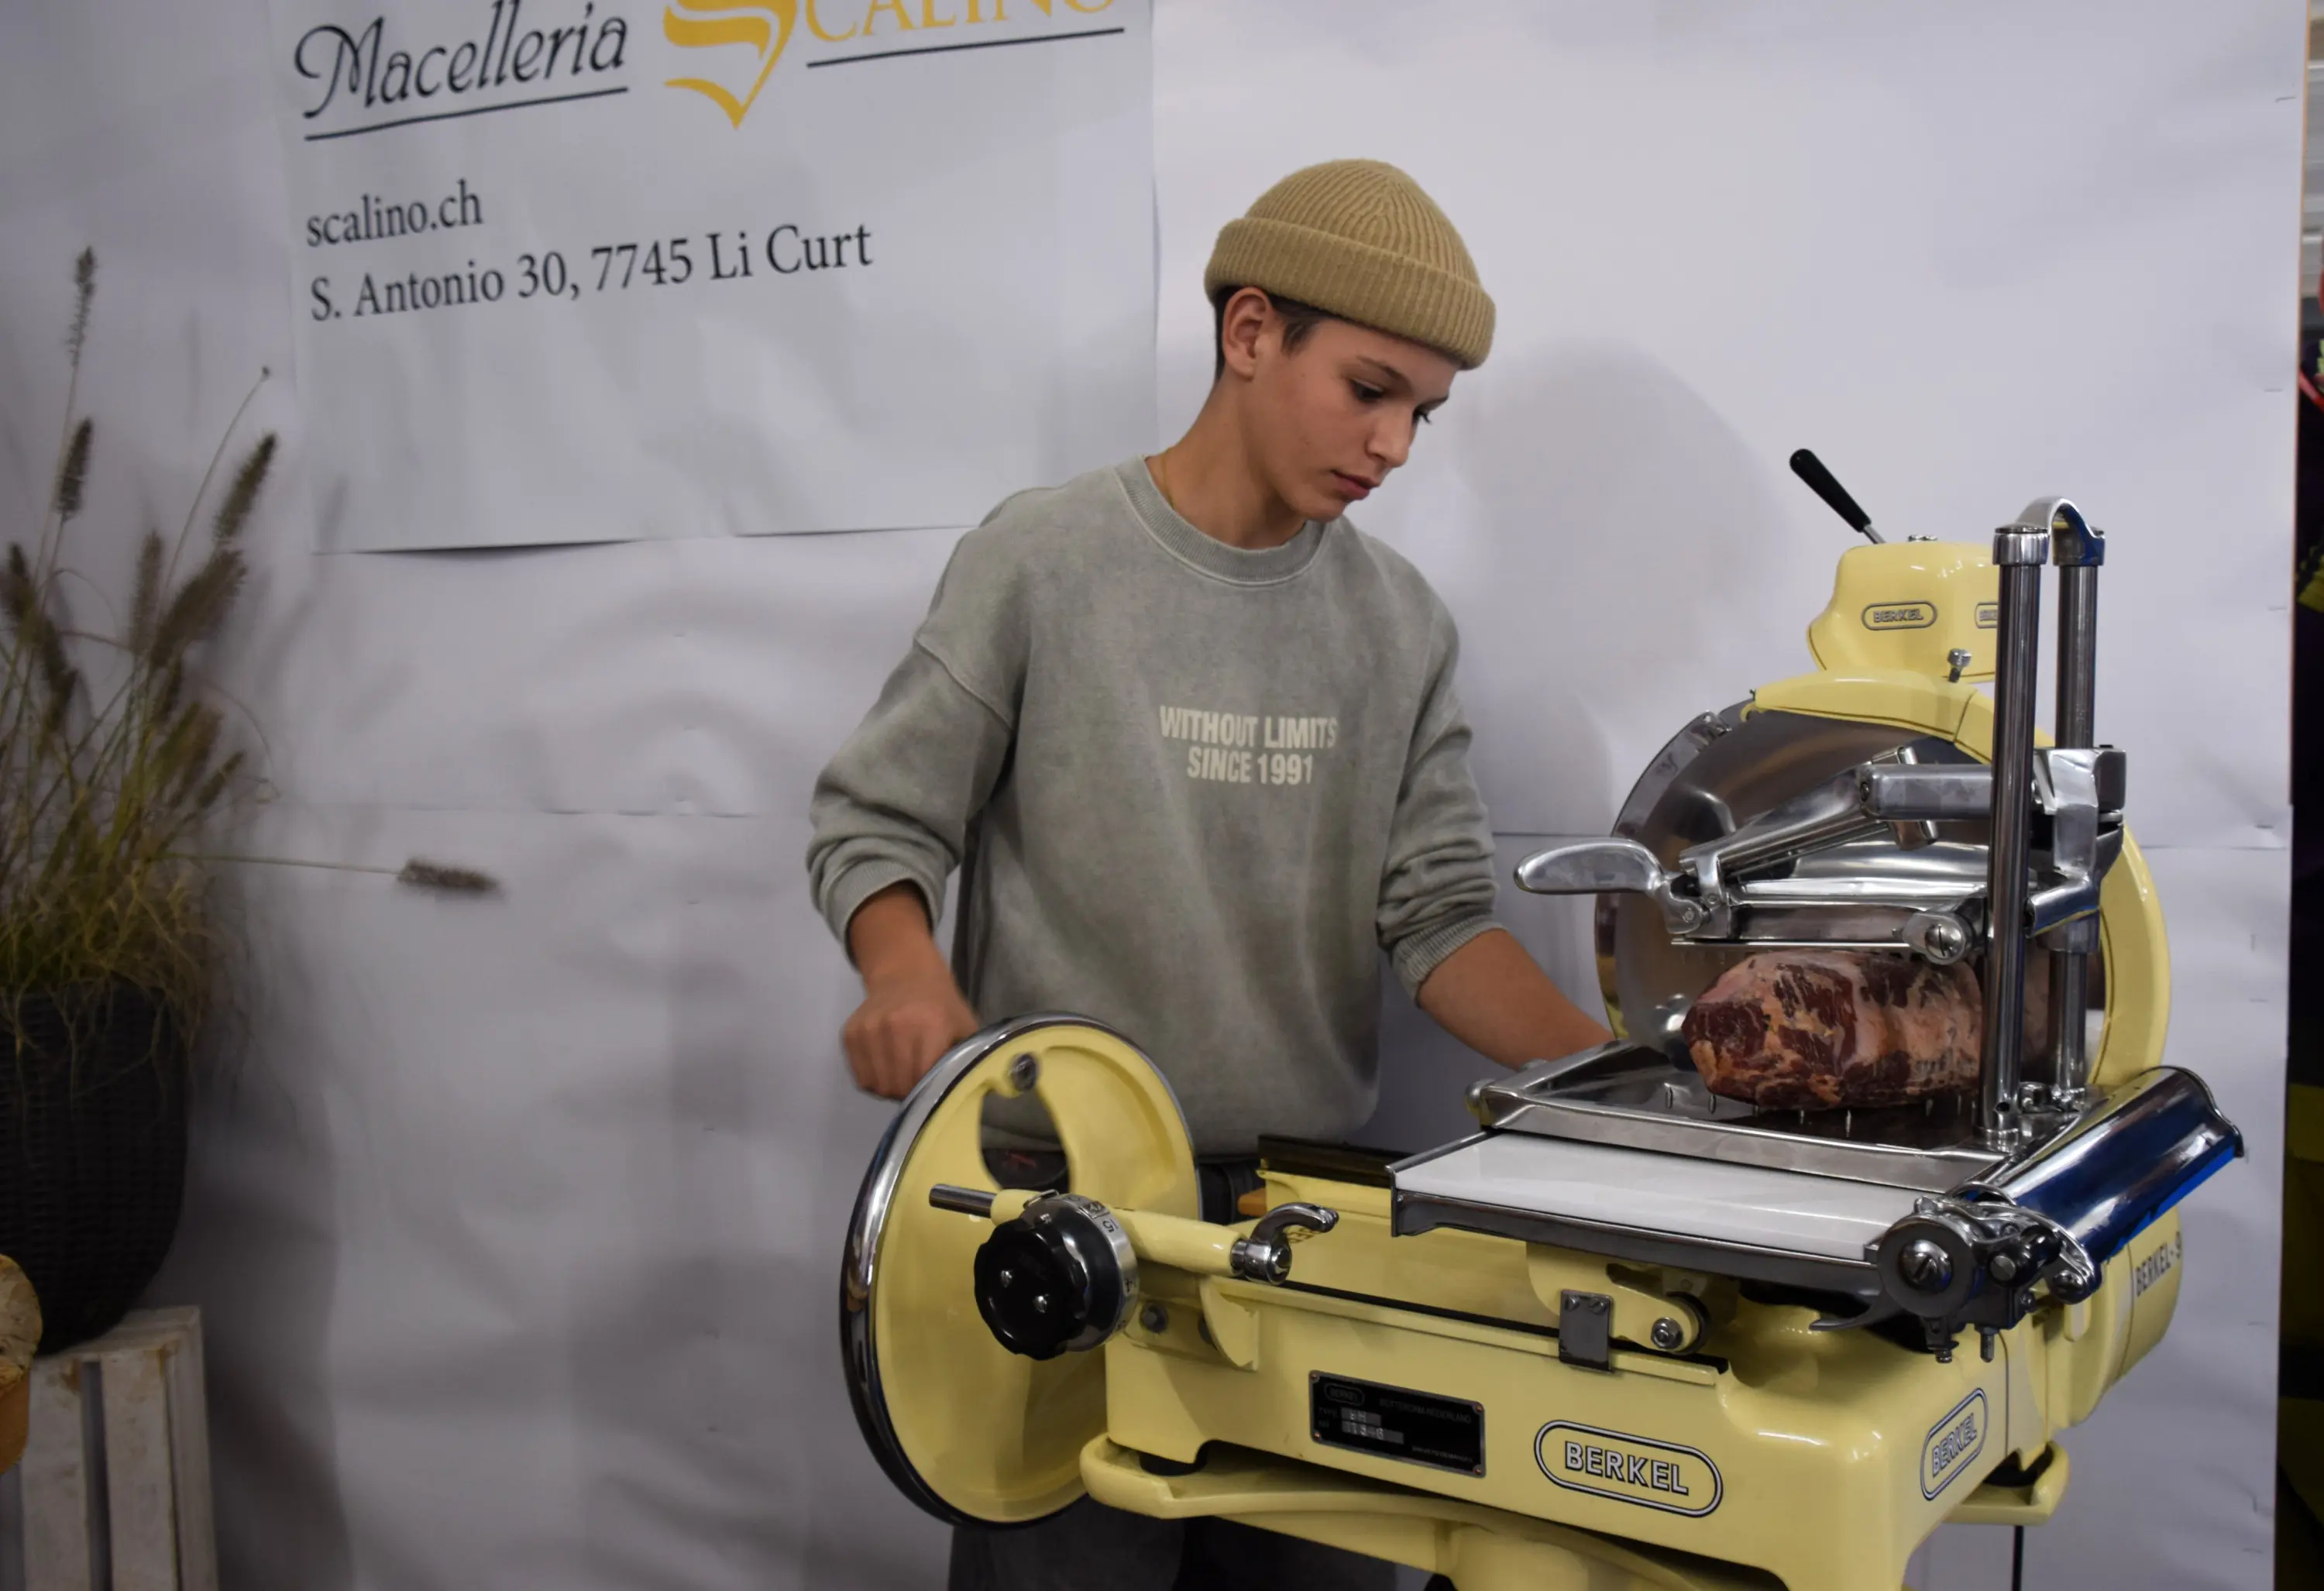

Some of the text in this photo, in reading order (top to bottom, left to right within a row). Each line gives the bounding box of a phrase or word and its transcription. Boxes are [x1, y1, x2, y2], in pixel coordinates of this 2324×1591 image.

[294, 0, 627, 119] Macelleria
[306, 178, 483, 247] scalino.ch
[311, 224, 873, 321] S. Antonio 30, 7745 Li Curt
[1872, 609, 1924, 623] BERKEL
[1160, 705, 1339, 750] WITHOUT LIMITS
[1187, 747, 1314, 785] SINCE 1991
[1564, 1439, 1690, 1497] BERKEL
[1931, 1411, 1977, 1478] BERKEL
